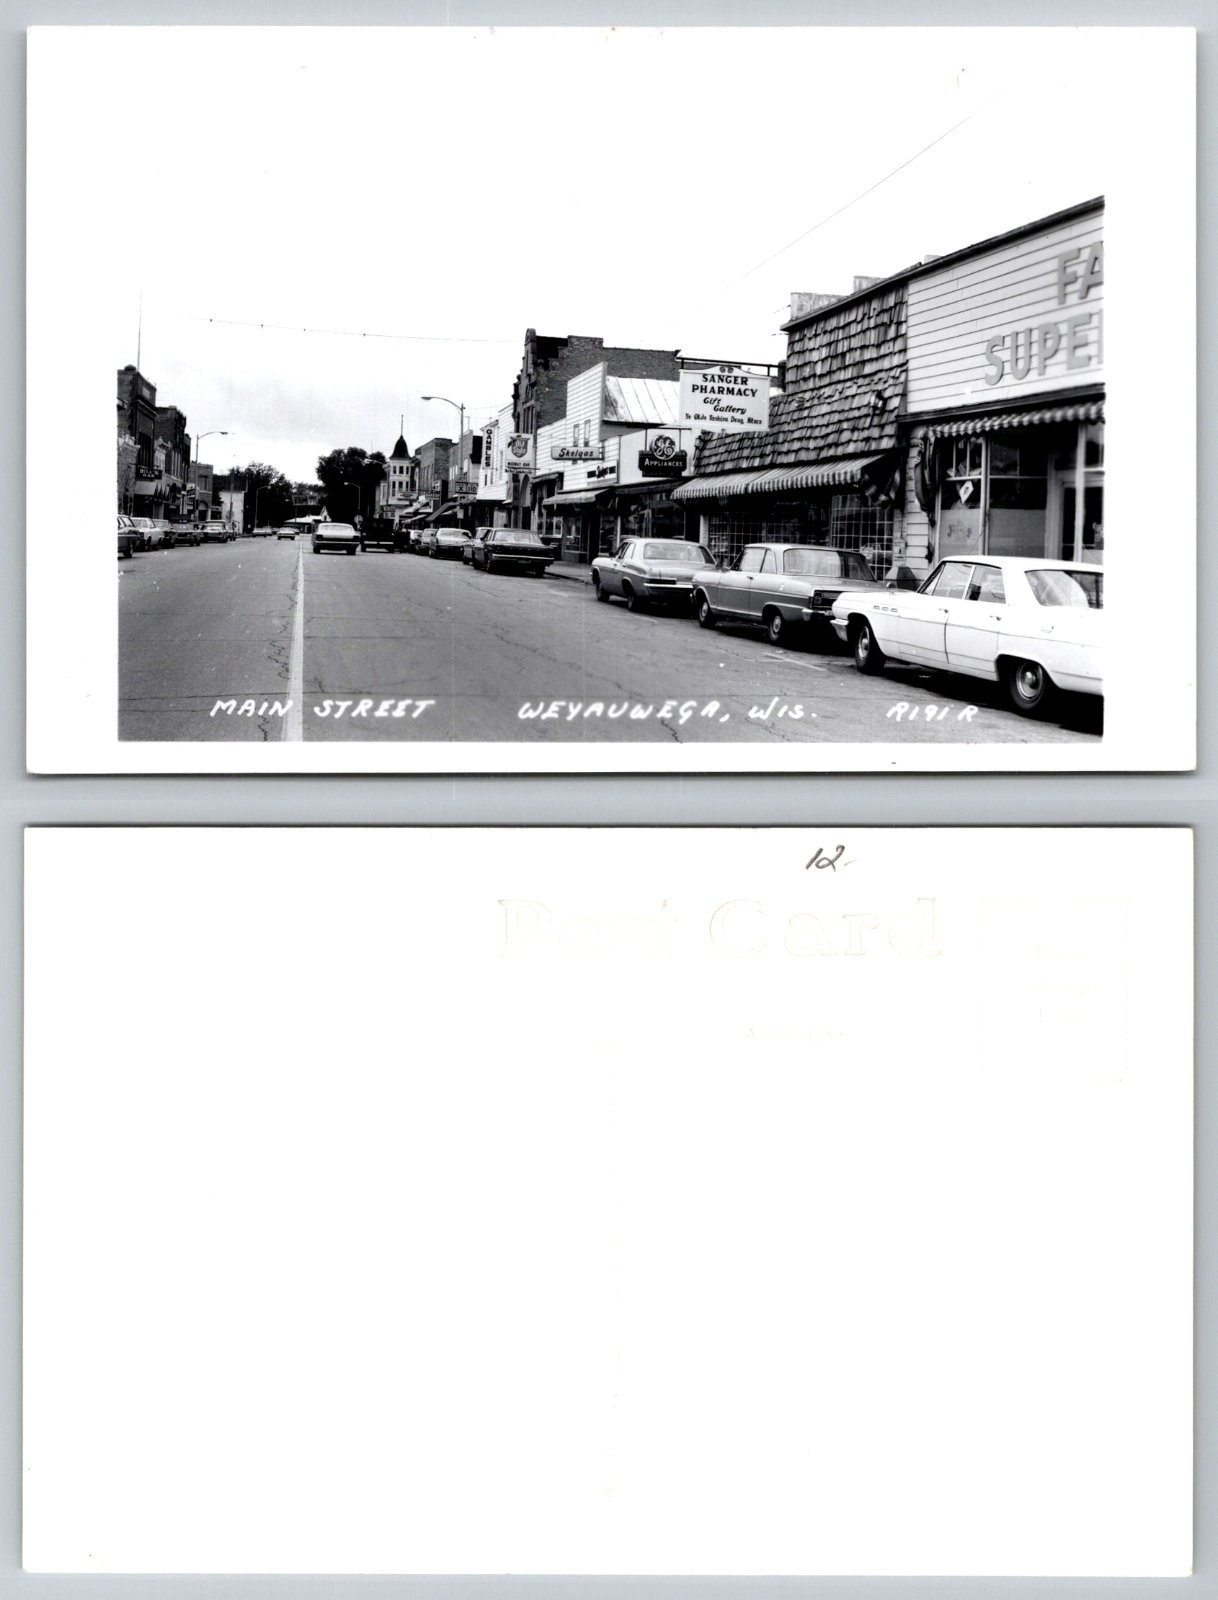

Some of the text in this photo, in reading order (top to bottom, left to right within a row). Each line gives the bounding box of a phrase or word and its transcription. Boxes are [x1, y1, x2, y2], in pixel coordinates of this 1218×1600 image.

[702, 374, 749, 385] SANGER
[692, 384, 758, 397] PHARMACY
[703, 397, 722, 405] Gift
[713, 405, 747, 415] Gallery
[694, 413, 707, 421] Olde
[559, 447, 594, 459] Skelgas
[707, 896, 944, 960] Card
